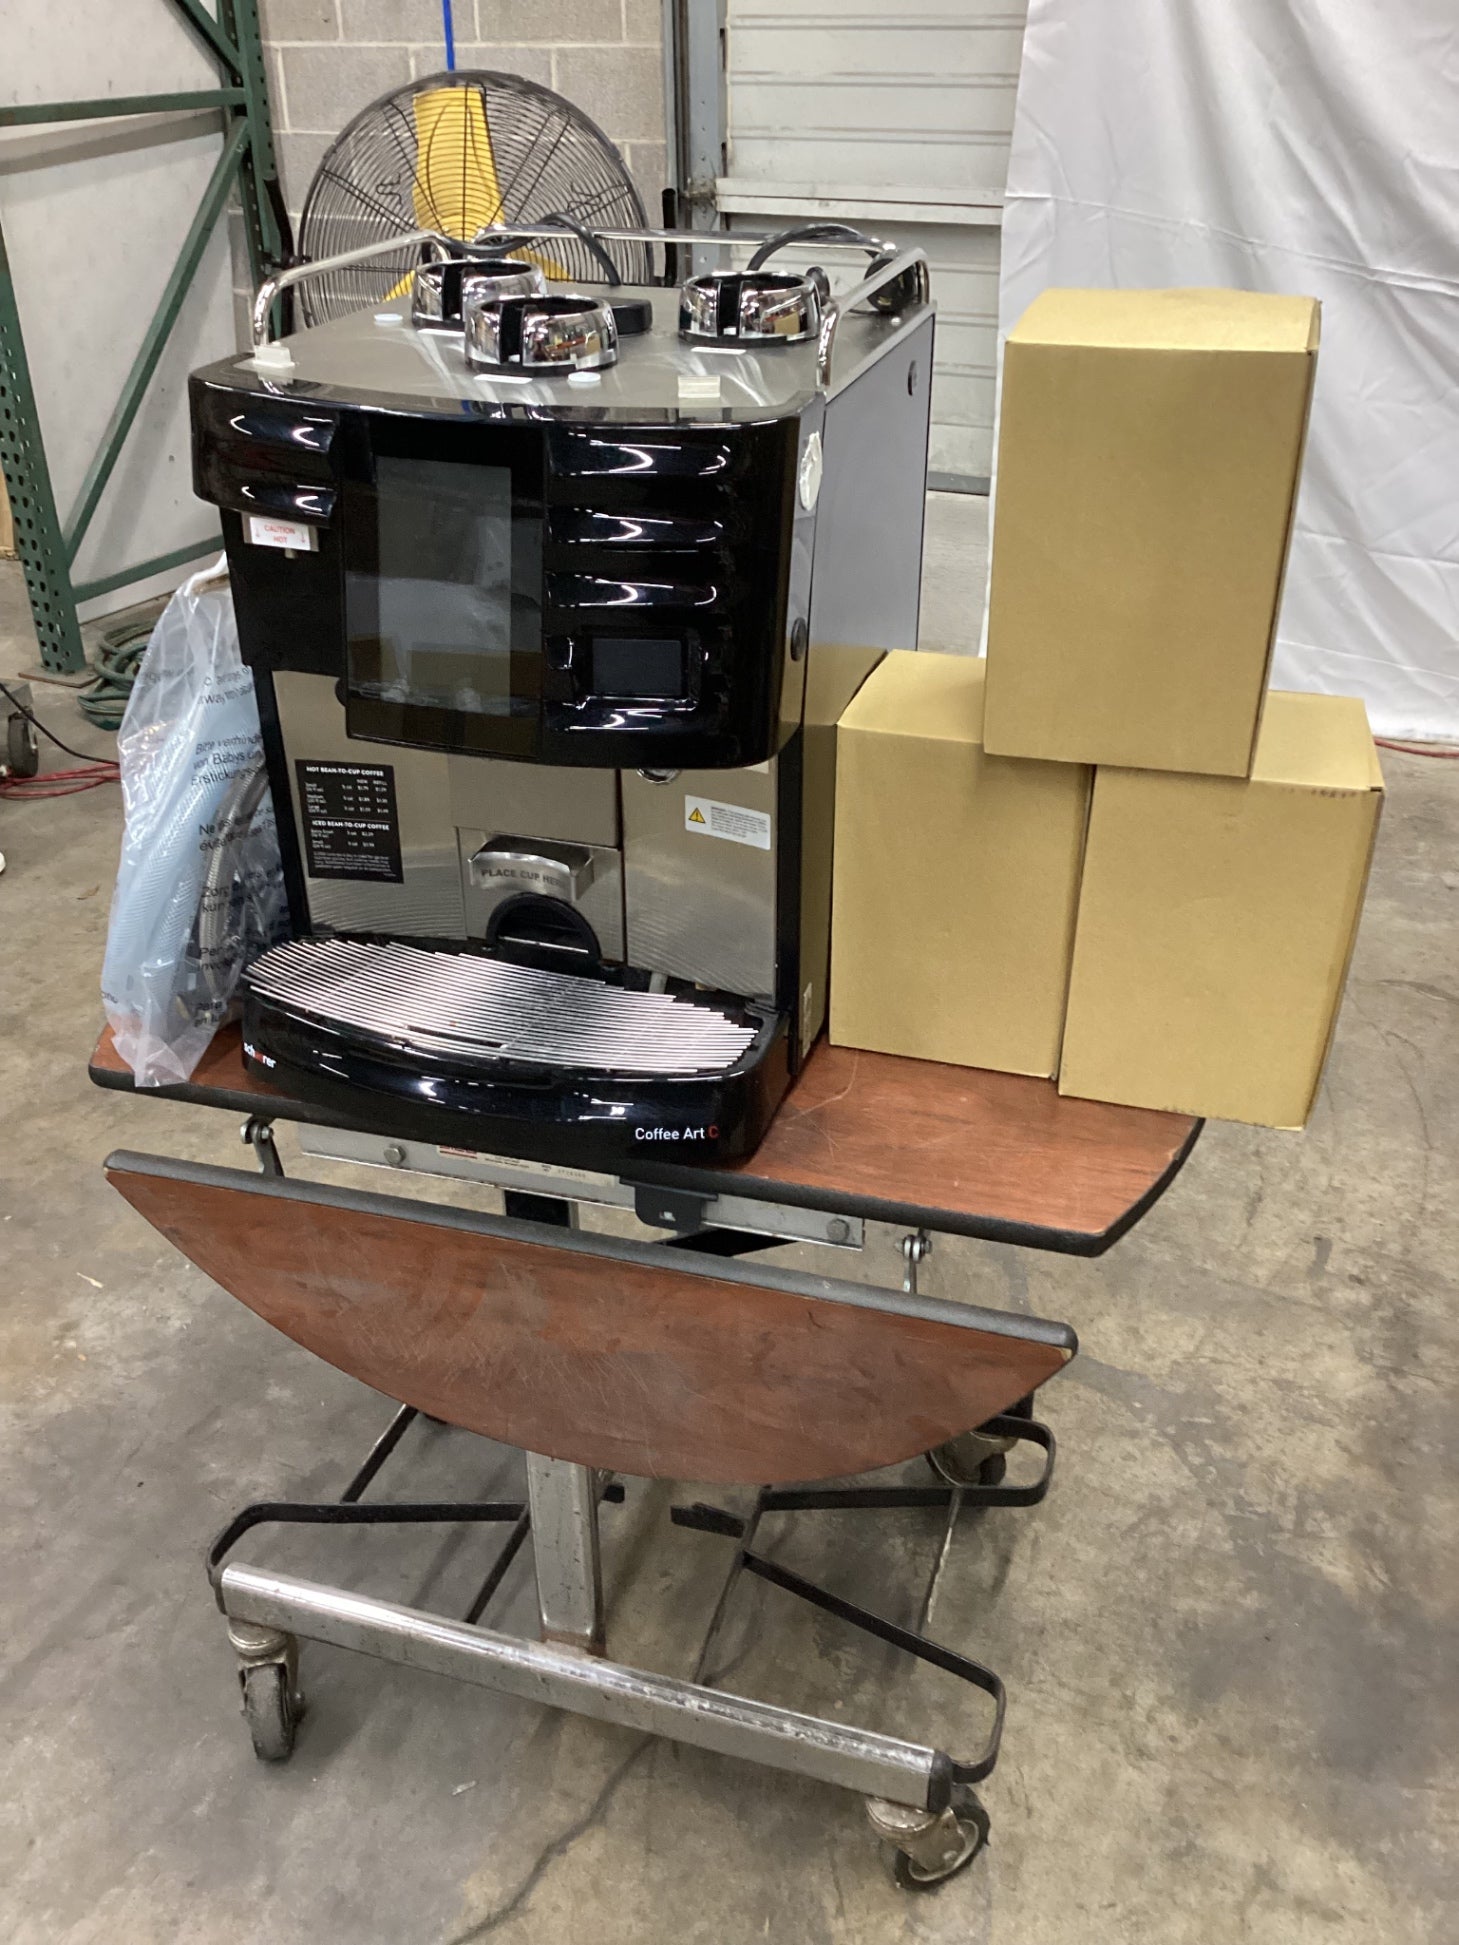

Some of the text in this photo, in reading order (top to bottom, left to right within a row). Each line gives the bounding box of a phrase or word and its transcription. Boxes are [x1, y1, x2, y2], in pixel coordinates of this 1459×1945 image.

[264, 525, 295, 534] CAUTION
[213, 752, 245, 765] Babys
[320, 767, 360, 775] BEAN-TO-CUP
[481, 869, 517, 878] PLACE
[520, 871, 540, 880] CUP
[635, 1125, 719, 1140] Coffee Art C
